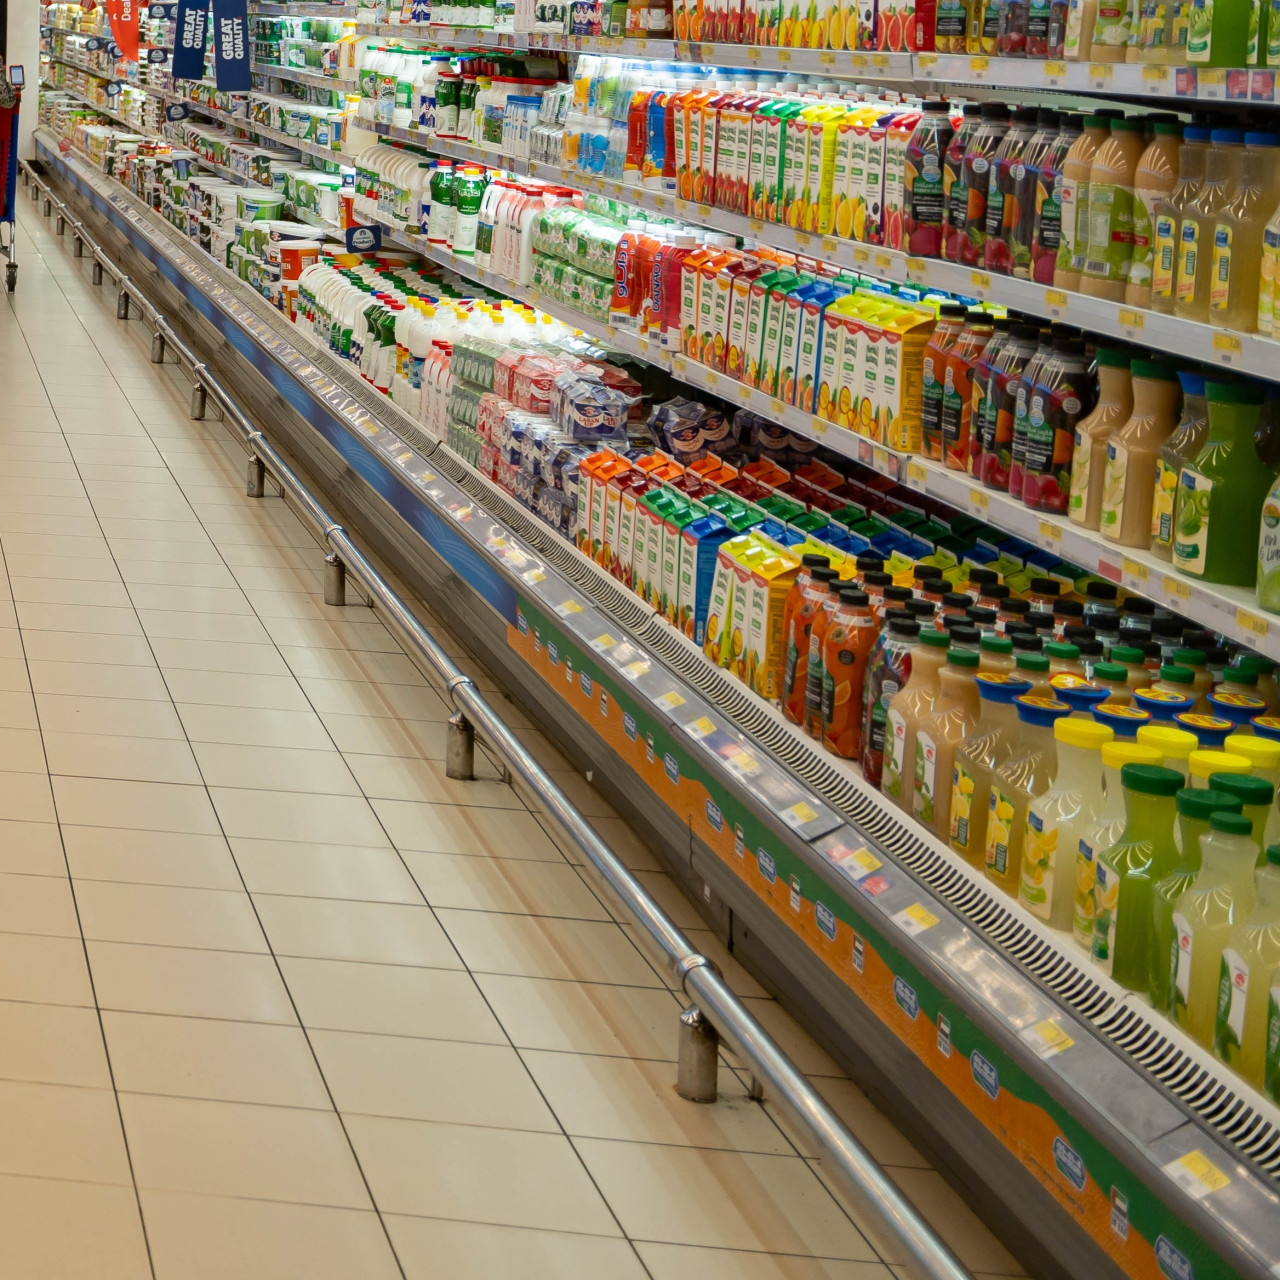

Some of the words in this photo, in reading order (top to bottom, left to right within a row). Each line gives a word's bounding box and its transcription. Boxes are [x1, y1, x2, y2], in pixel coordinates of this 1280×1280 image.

[182, 8, 196, 48] GREAT
[222, 18, 233, 60] GREAT
[653, 264, 661, 312] DANAO
